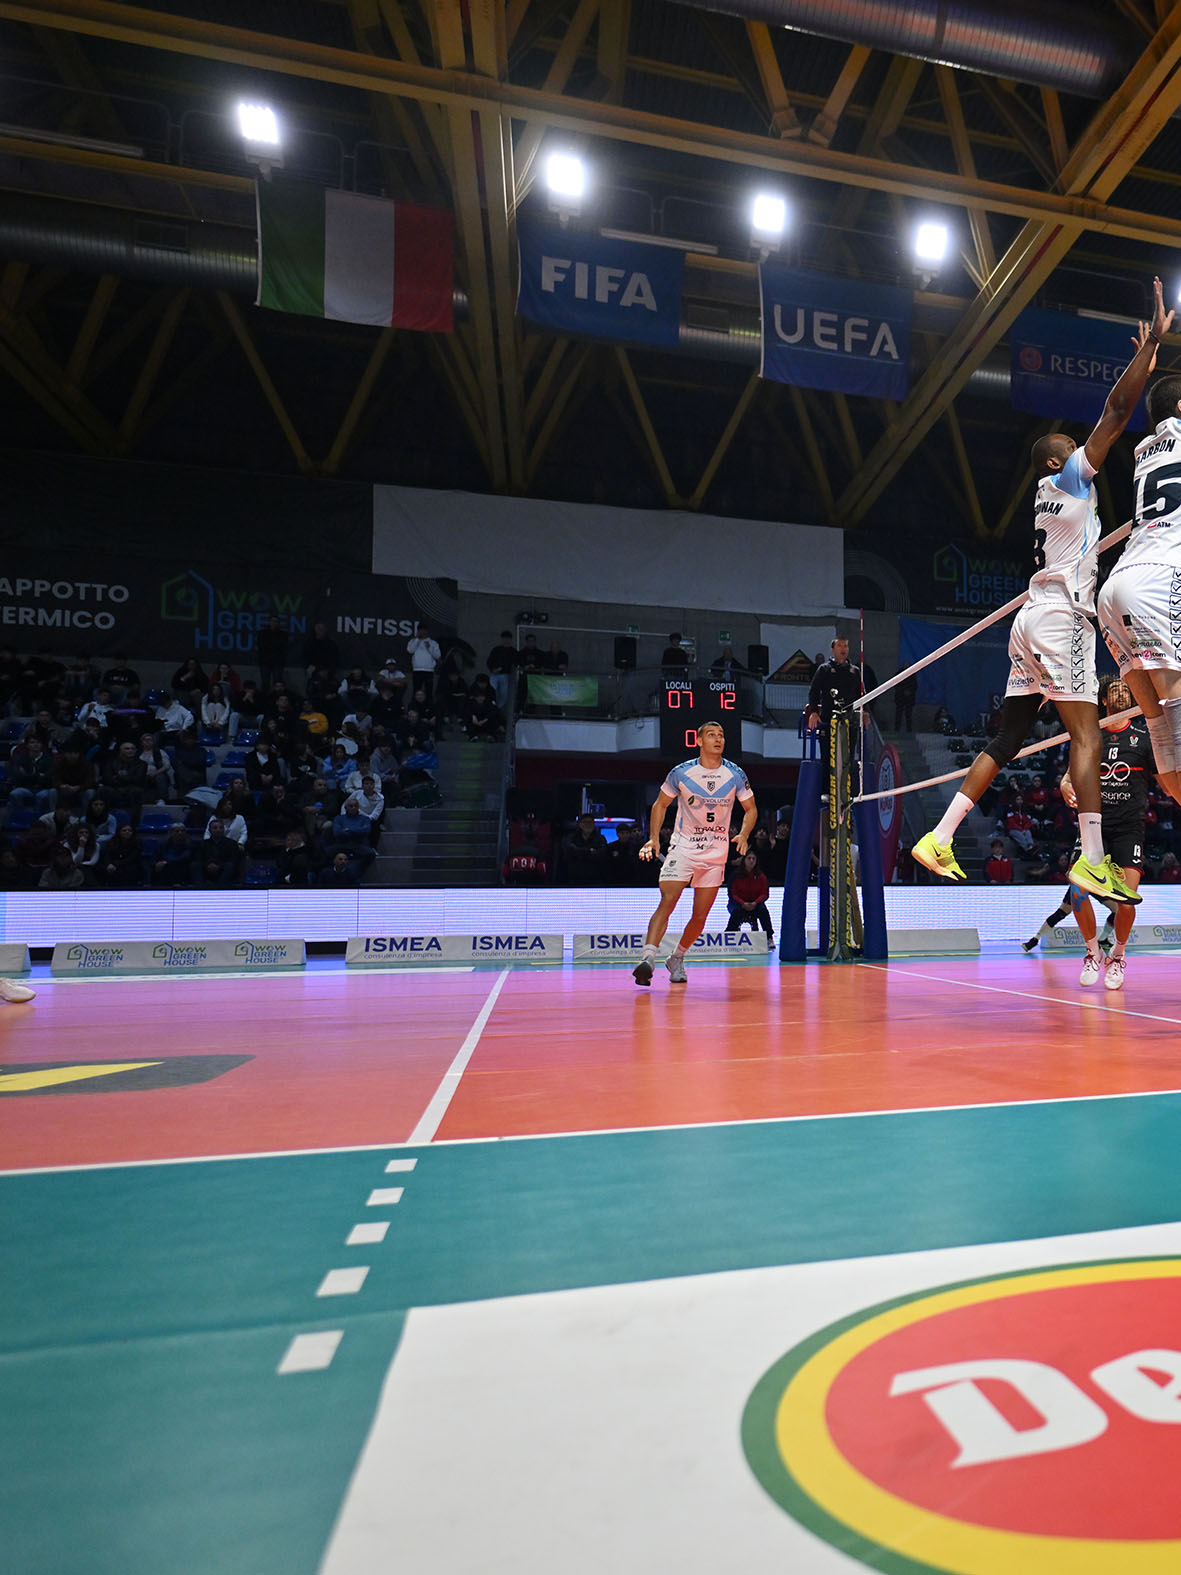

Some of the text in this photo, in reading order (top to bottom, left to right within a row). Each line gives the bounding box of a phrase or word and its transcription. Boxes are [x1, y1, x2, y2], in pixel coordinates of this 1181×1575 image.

[542, 255, 658, 311] FIFA
[773, 303, 900, 360] UEFA
[1051, 354, 1126, 383] RESPEC
[0, 577, 130, 603] APPOTTO
[968, 573, 1027, 592] GREEN
[217, 589, 304, 612] WOW
[0, 605, 116, 631] ERMICO
[194, 626, 260, 652] HOU
[665, 681, 693, 691] LOCALI
[709, 682, 736, 692] OSPITI
[668, 690, 694, 709] 07
[720, 692, 736, 710] 12
[1108, 747, 1119, 760] 13
[829, 719, 838, 830] CREDEM BANCA
[1100, 791, 1131, 800] sence
[706, 812, 715, 823] 5
[364, 937, 442, 953] ISMEA
[471, 936, 546, 951] ISMEA
[590, 934, 644, 949] ISME
[693, 932, 753, 947] SMEA
[88, 953, 124, 962] GREEN
[172, 952, 208, 961] GREEN
[245, 956, 279, 964] HOUSE
[254, 950, 288, 958] GREEN
[78, 960, 114, 968] HOUSE
[164, 958, 198, 967] HOUSE
